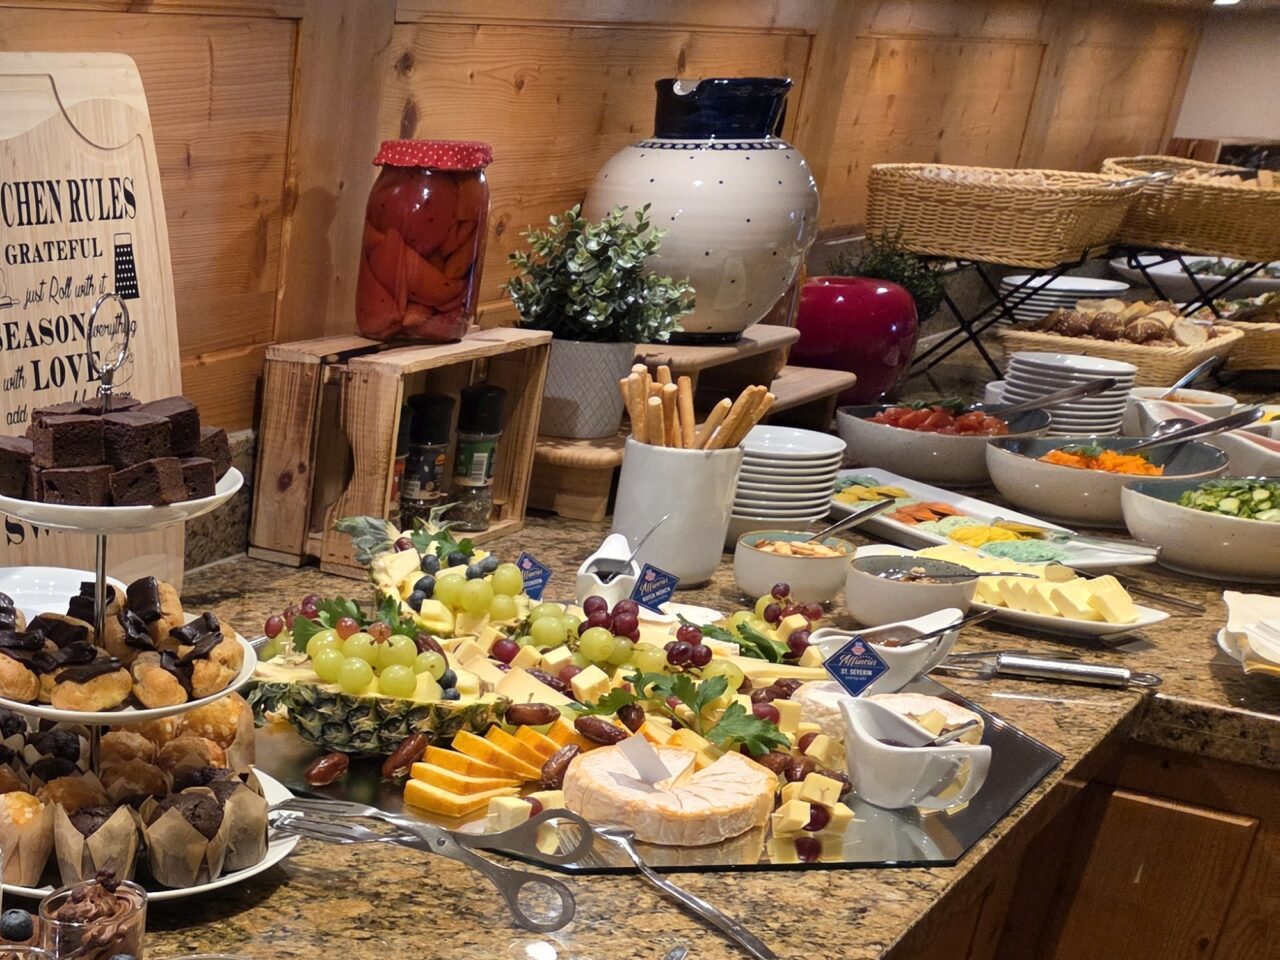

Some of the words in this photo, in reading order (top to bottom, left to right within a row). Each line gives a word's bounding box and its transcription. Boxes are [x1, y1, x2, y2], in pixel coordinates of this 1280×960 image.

[66, 177, 136, 223] RULES
[5, 237, 103, 265] GRATEFUL
[23, 278, 47, 309] just
[49, 275, 72, 304] Roll
[75, 274, 97, 299] with
[99, 273, 108, 295] it
[3, 365, 27, 392] with
[30, 351, 101, 392] LOVE
[6, 404, 28, 425] add
